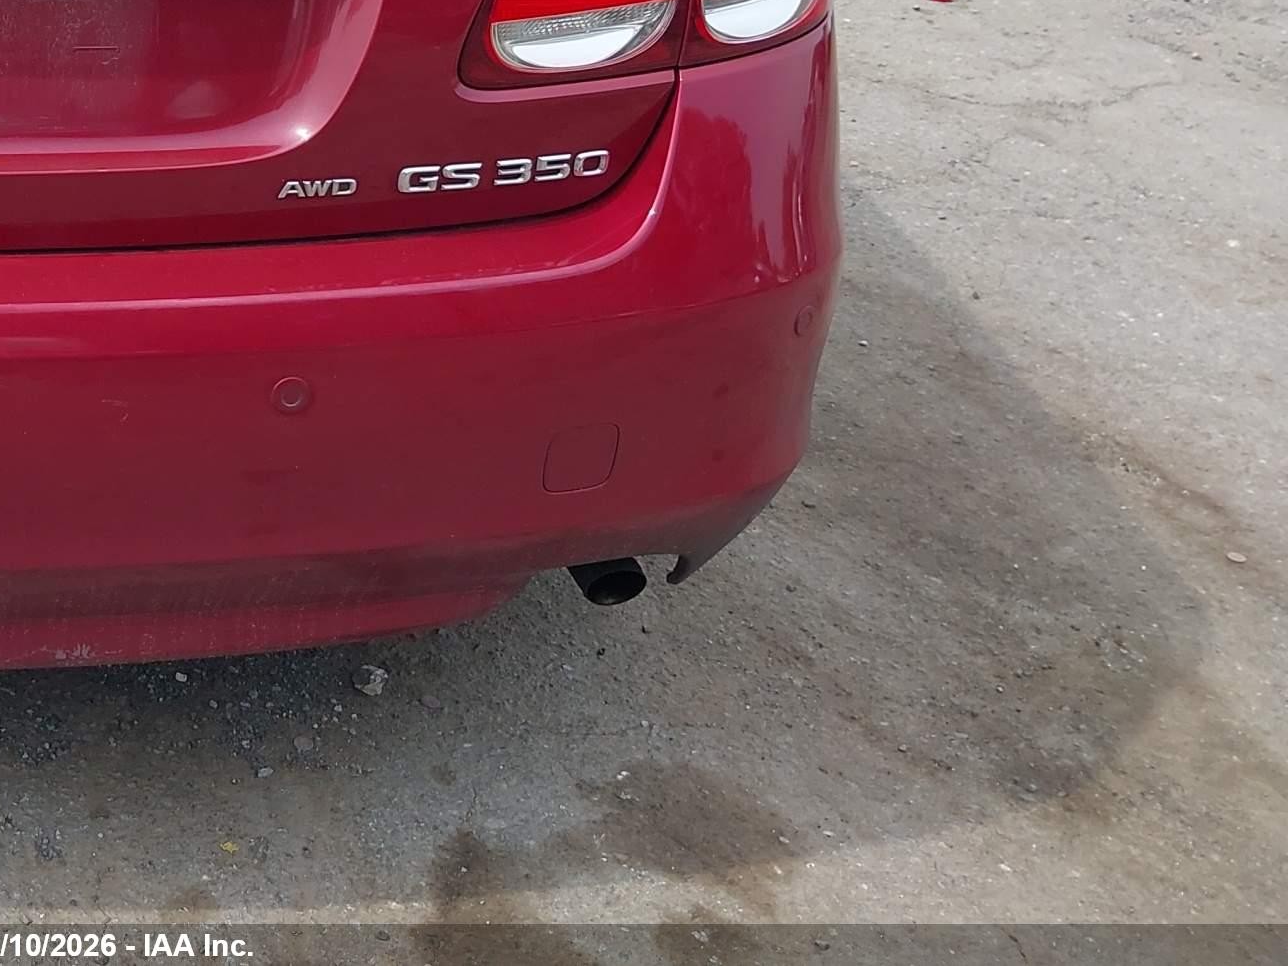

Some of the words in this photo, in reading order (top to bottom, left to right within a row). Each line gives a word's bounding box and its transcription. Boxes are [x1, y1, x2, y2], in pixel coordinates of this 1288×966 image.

[278, 178, 358, 199] AWD
[397, 162, 483, 193] GS
[494, 149, 610, 186] 350
